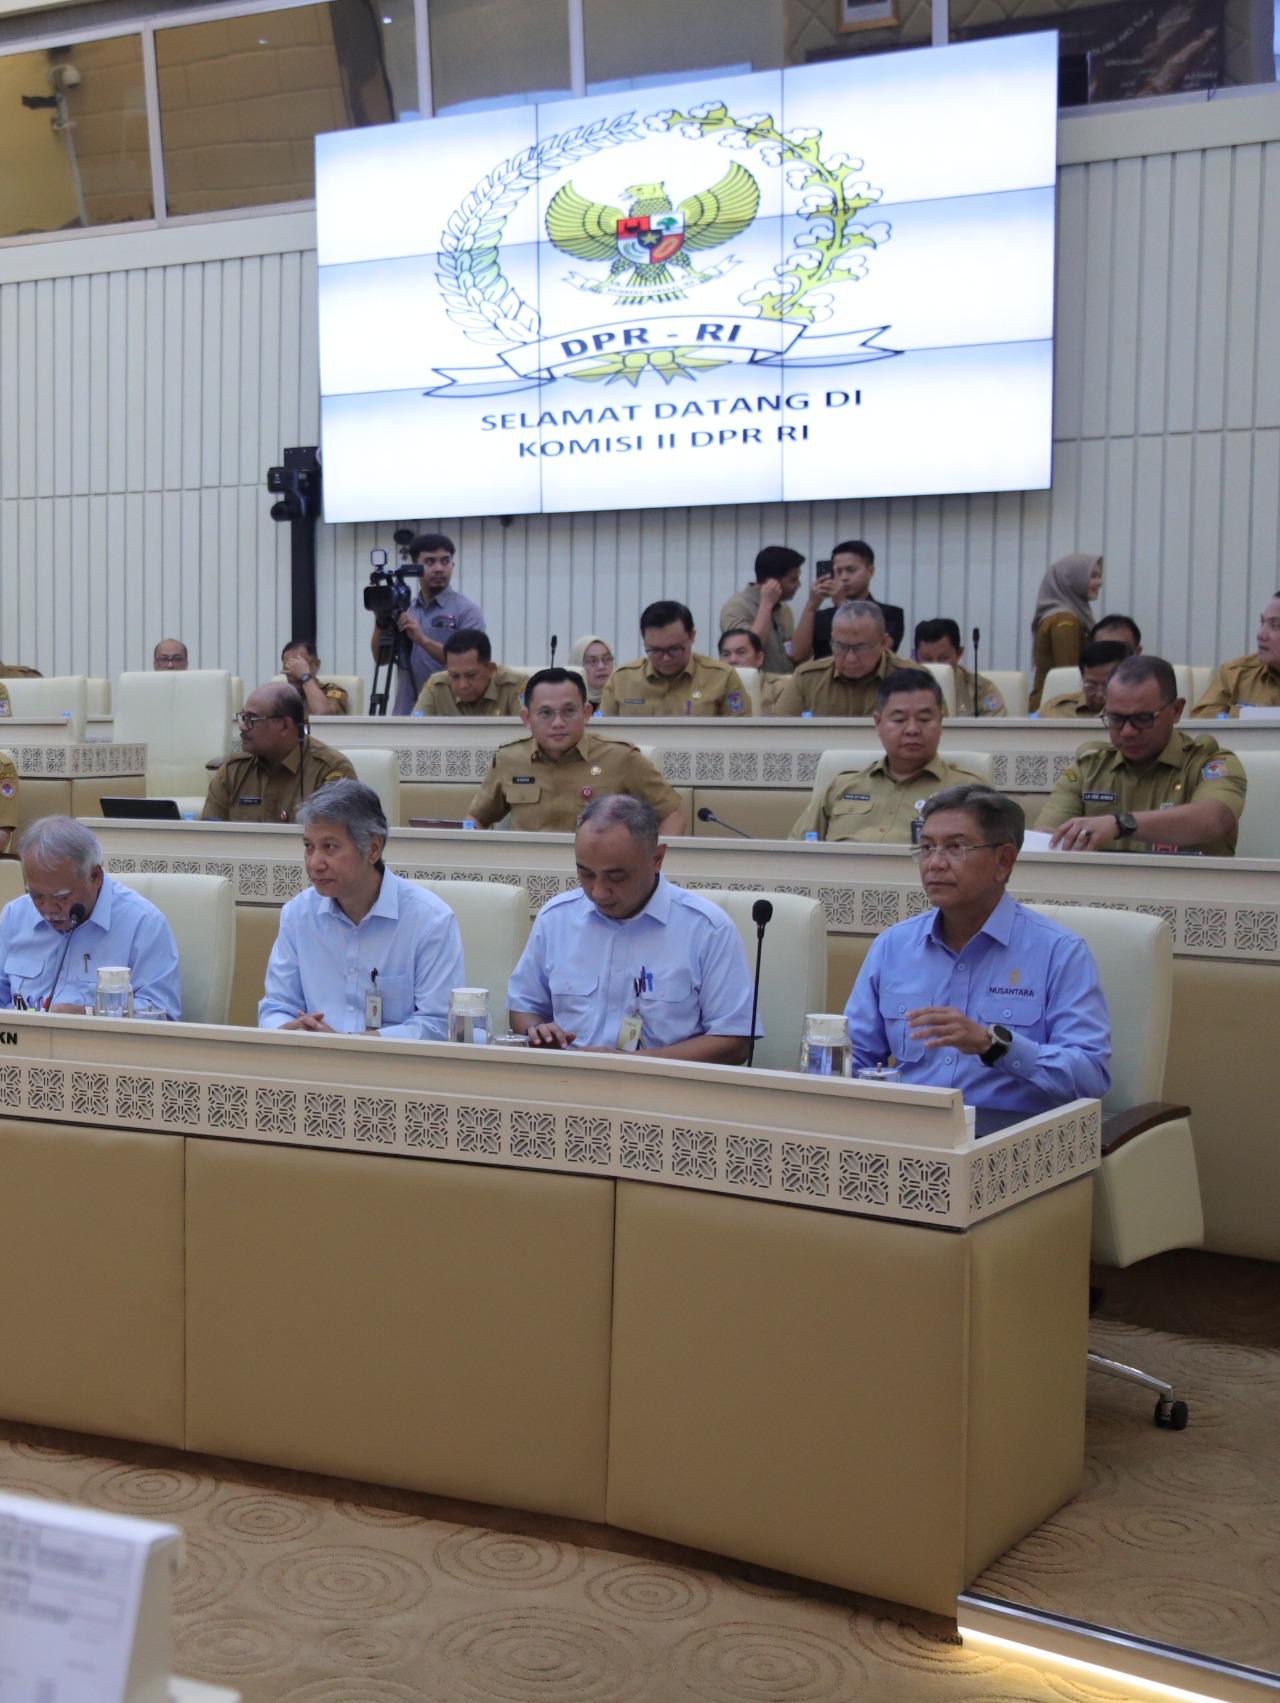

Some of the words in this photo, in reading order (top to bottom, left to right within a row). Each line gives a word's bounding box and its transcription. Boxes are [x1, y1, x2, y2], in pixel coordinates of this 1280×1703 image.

[561, 327, 649, 358] DPR
[696, 323, 741, 342] RI
[481, 405, 641, 431] SELAMAT
[655, 393, 809, 419] DATANG
[825, 390, 861, 407] DI
[519, 435, 642, 458] KOMISI
[658, 433, 675, 449] II
[691, 428, 762, 448] DPR
[777, 425, 808, 442] RI
[989, 987, 1034, 997] NUSANTARA
